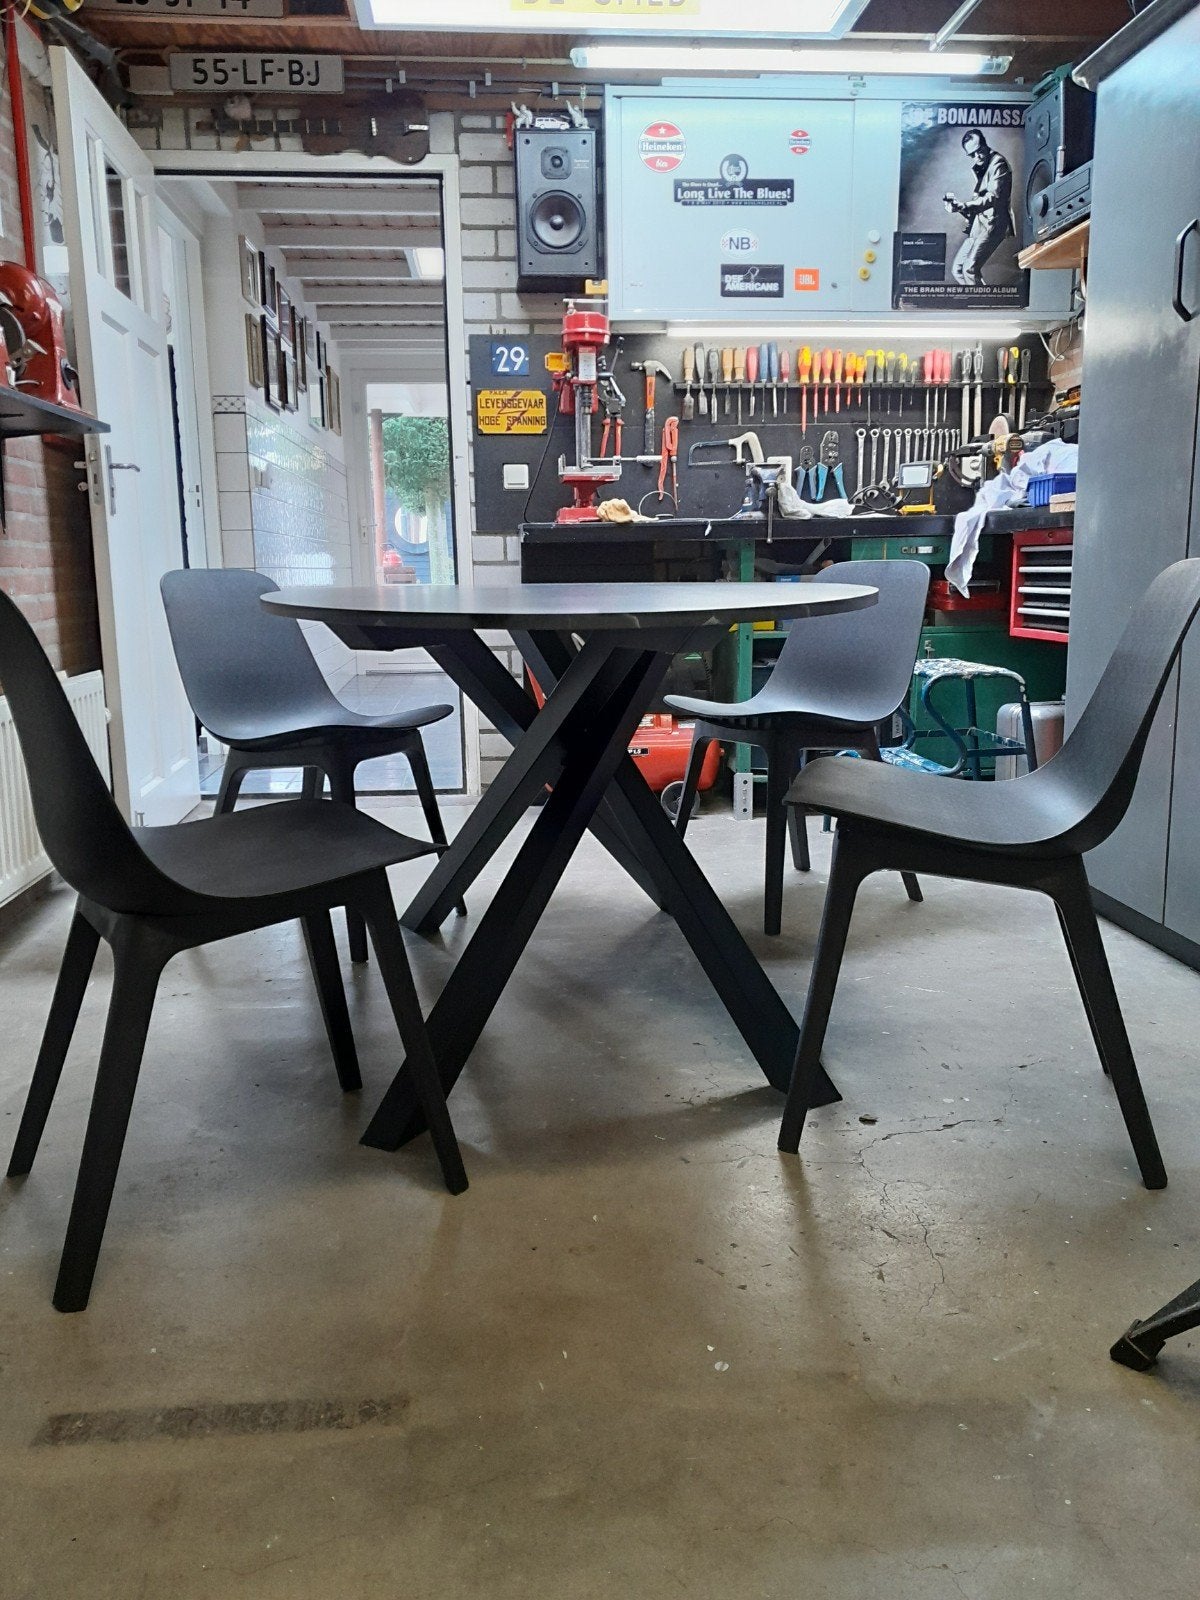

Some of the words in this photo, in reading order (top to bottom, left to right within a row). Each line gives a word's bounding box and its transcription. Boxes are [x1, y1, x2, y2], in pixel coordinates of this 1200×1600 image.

[642, 141, 682, 151] Heineken
[677, 187, 705, 202] Long
[707, 187, 732, 199] Live
[732, 187, 754, 199] The
[756, 187, 792, 199] Blues!
[728, 237, 751, 250] NB
[724, 274, 744, 283] DEF
[799, 274, 815, 285] JBL
[724, 282, 780, 291] AMERICANS
[964, 286, 991, 294] STUDIO
[992, 286, 1019, 294] ALBUM
[495, 346, 525, 372] 29
[479, 398, 544, 409] LEVENSGEVAAR
[479, 415, 501, 426] HOGE
[506, 415, 546, 426] SPANNING
